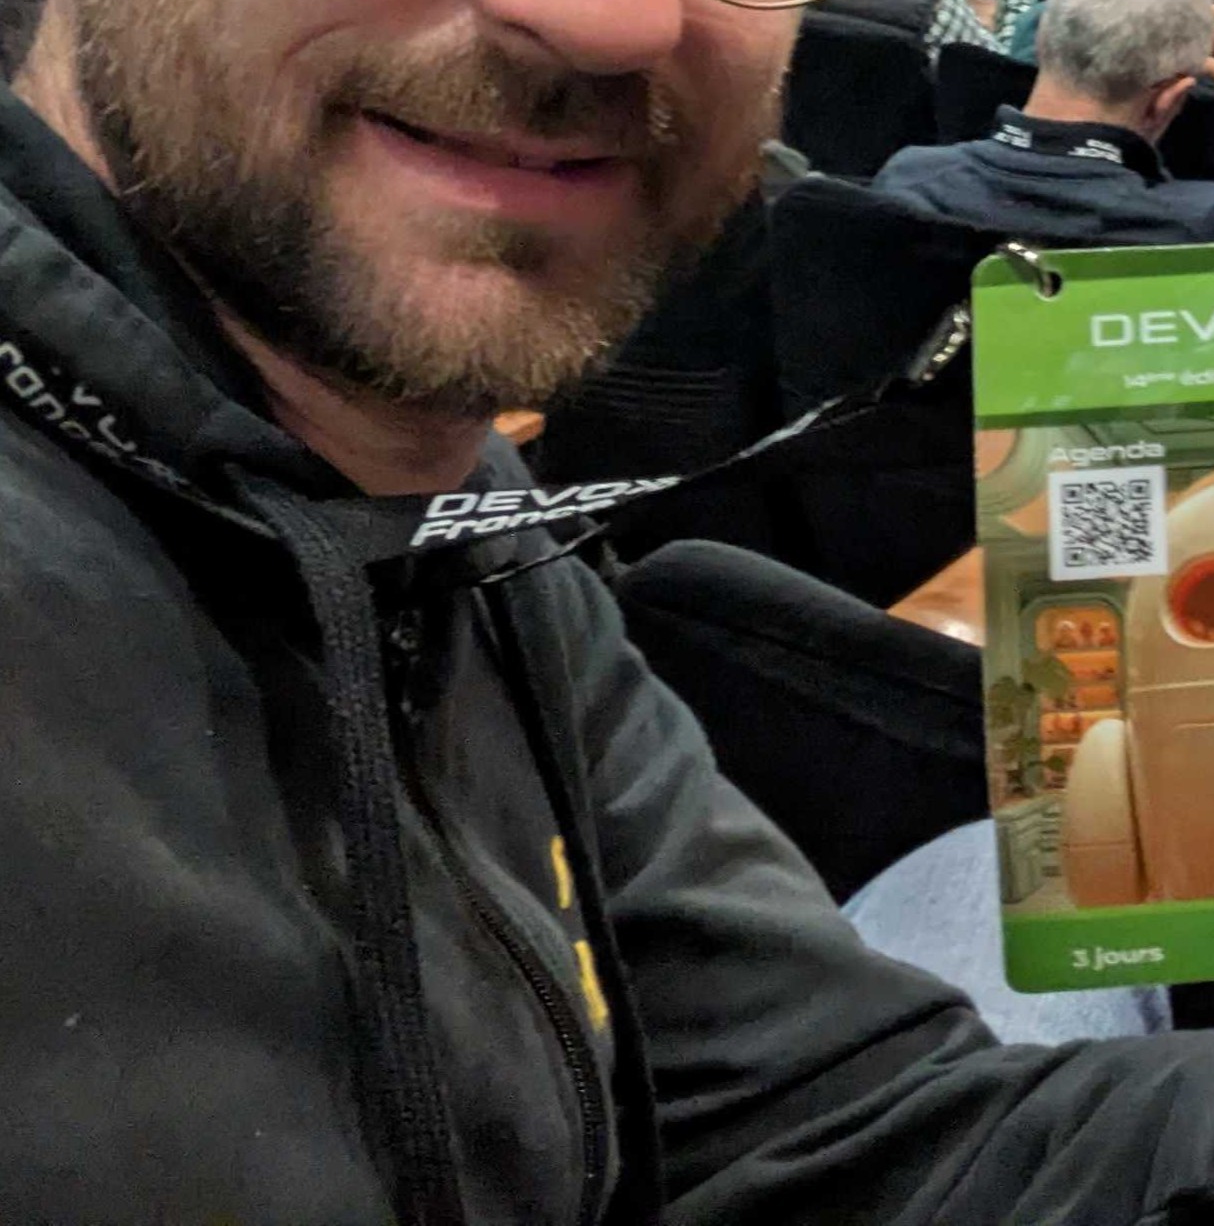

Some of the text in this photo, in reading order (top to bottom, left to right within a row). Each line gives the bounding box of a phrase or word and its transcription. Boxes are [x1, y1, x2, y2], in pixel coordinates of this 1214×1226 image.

[1048, 440, 1165, 467] Agenda
[1073, 944, 1165, 971] 3 jours
